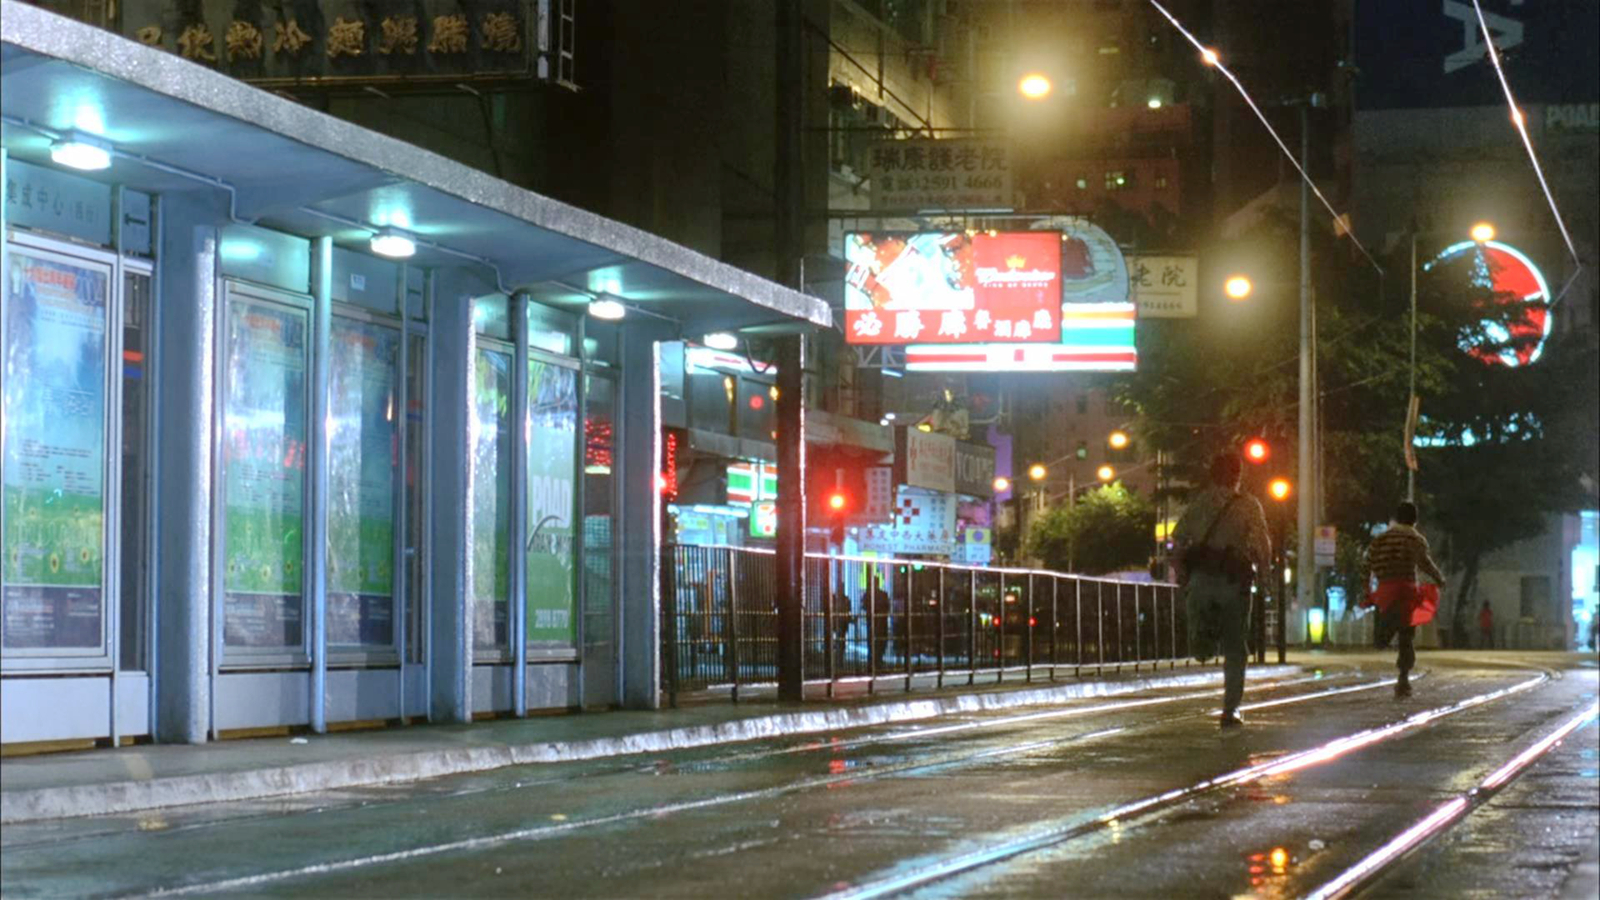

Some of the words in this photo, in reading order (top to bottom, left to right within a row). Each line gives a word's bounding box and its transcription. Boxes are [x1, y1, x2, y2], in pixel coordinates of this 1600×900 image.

[872, 145, 1008, 172] 瑞康護老院
[532, 475, 571, 529] POAD
